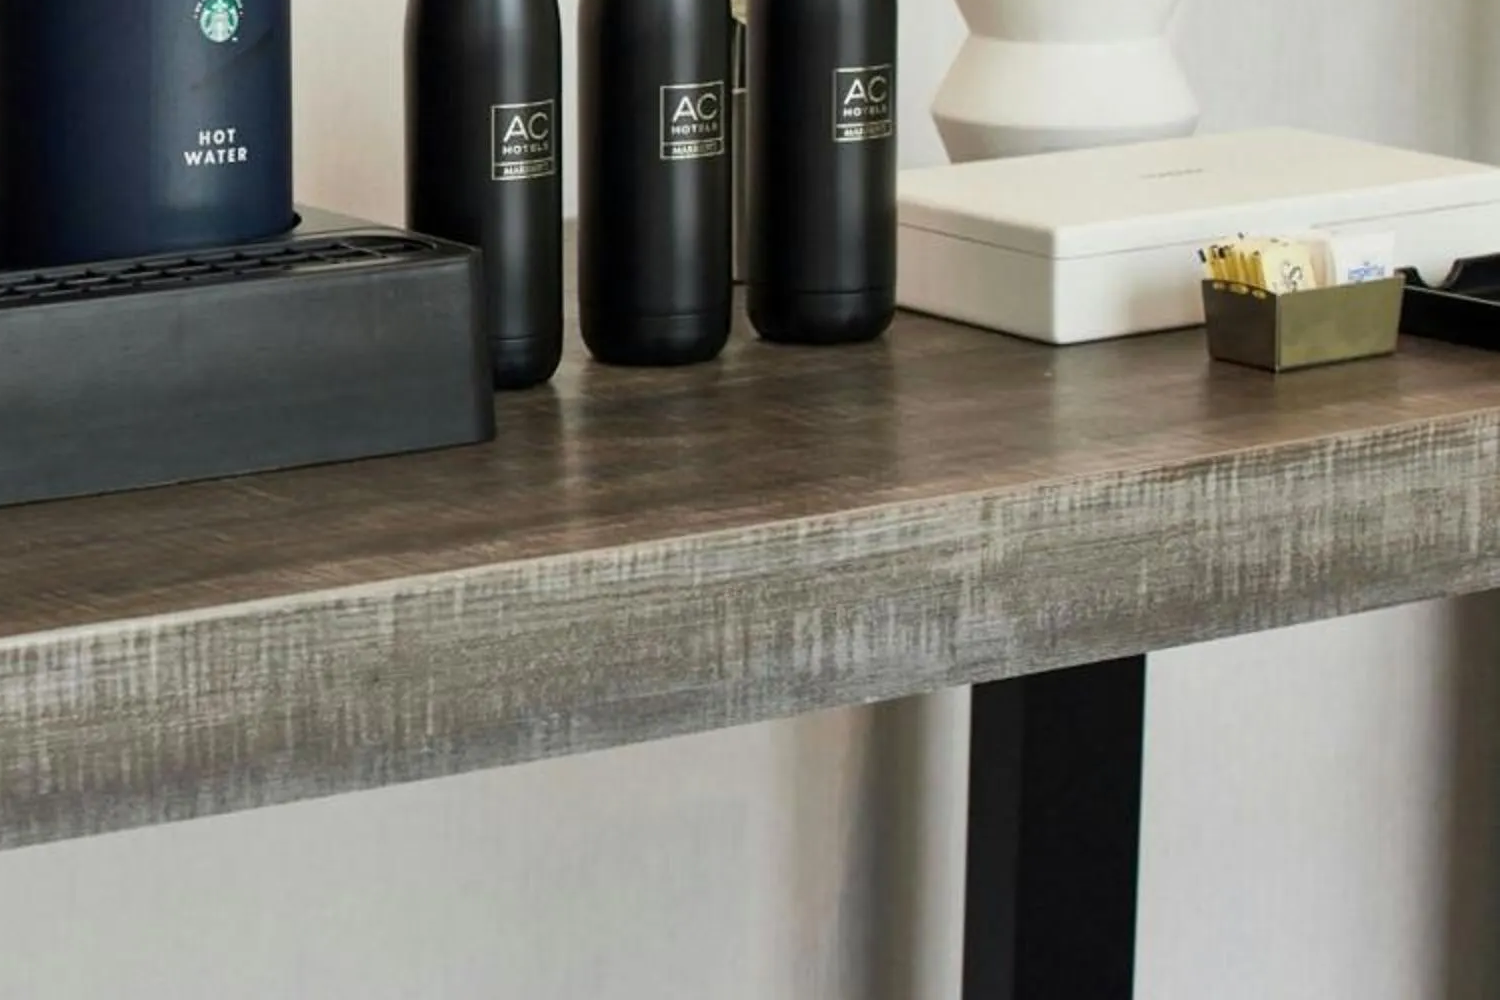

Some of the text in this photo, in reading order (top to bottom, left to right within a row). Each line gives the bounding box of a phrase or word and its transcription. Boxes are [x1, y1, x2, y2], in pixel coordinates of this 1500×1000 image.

[844, 75, 887, 104] AC
[672, 93, 717, 122] AC
[843, 103, 887, 117] HOTELS
[199, 127, 236, 146] HOT
[503, 111, 548, 142] AC
[671, 121, 718, 135] HOTELS
[183, 146, 248, 167] WATER
[502, 140, 548, 155] HOTELS
